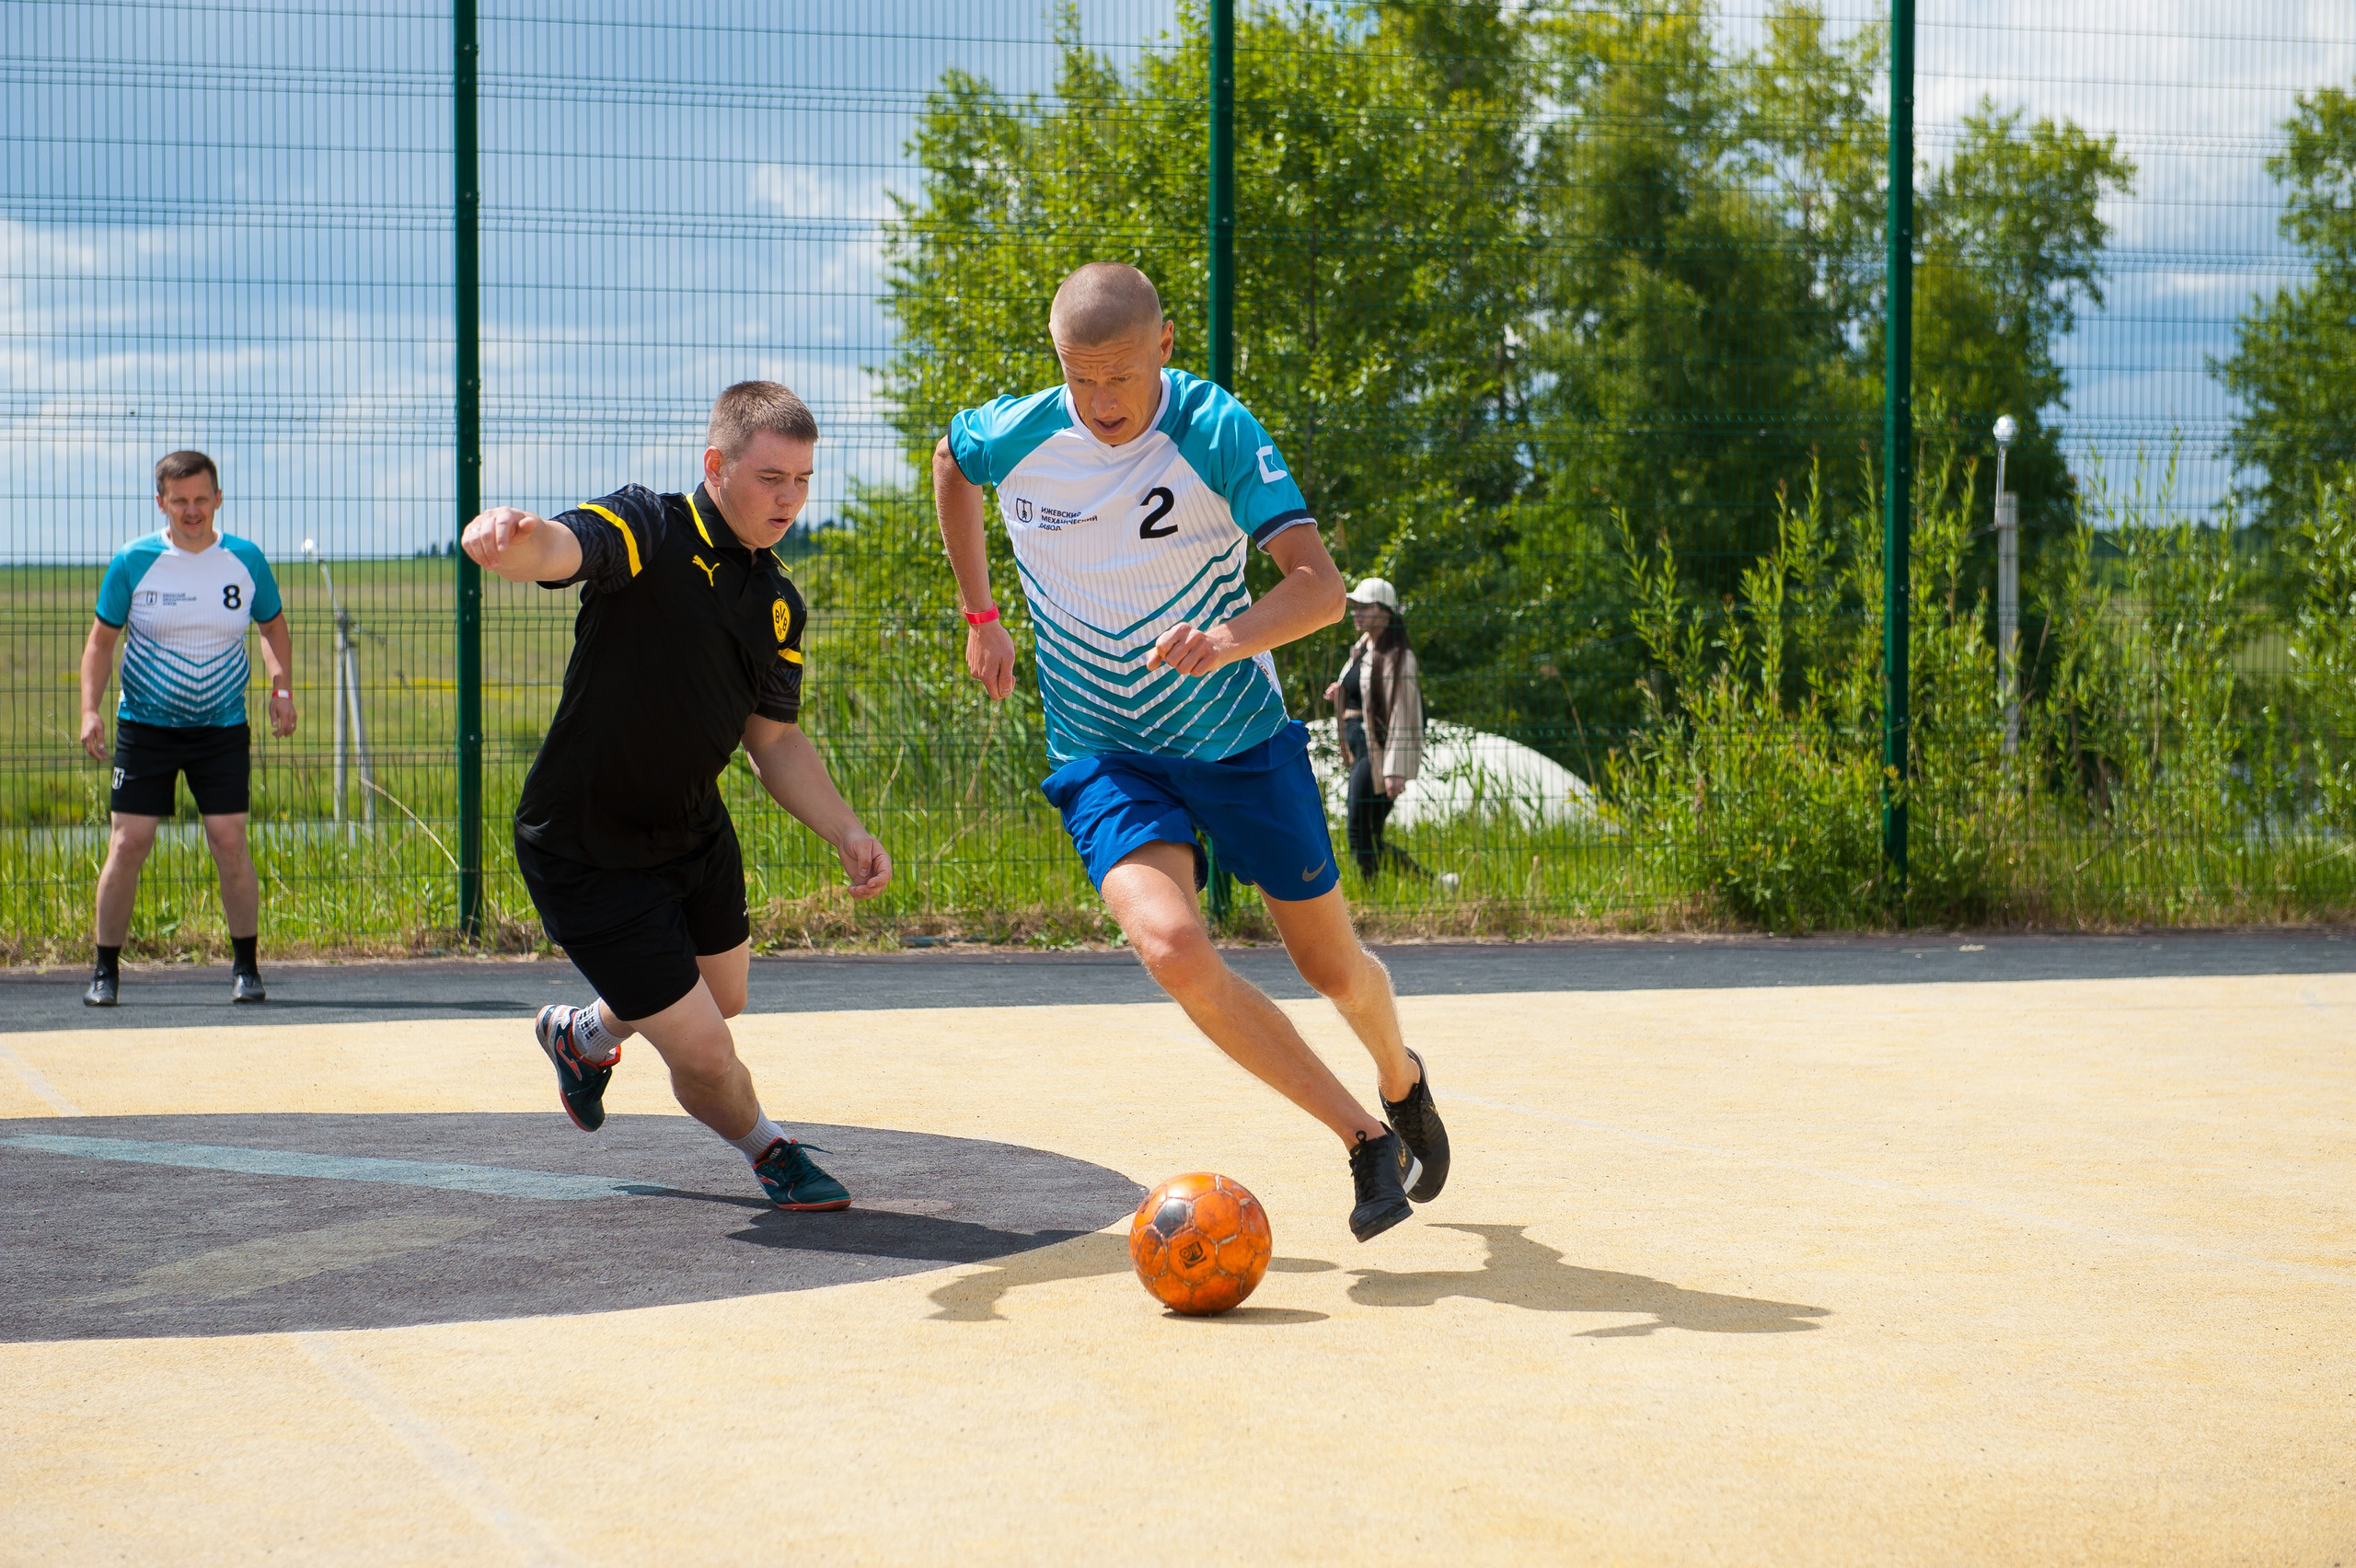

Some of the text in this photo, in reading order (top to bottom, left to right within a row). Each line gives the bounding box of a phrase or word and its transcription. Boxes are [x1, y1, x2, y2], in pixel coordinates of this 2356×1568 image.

[1139, 487, 1178, 539] 2
[223, 584, 241, 610] 8
[775, 604, 788, 632] BVB
